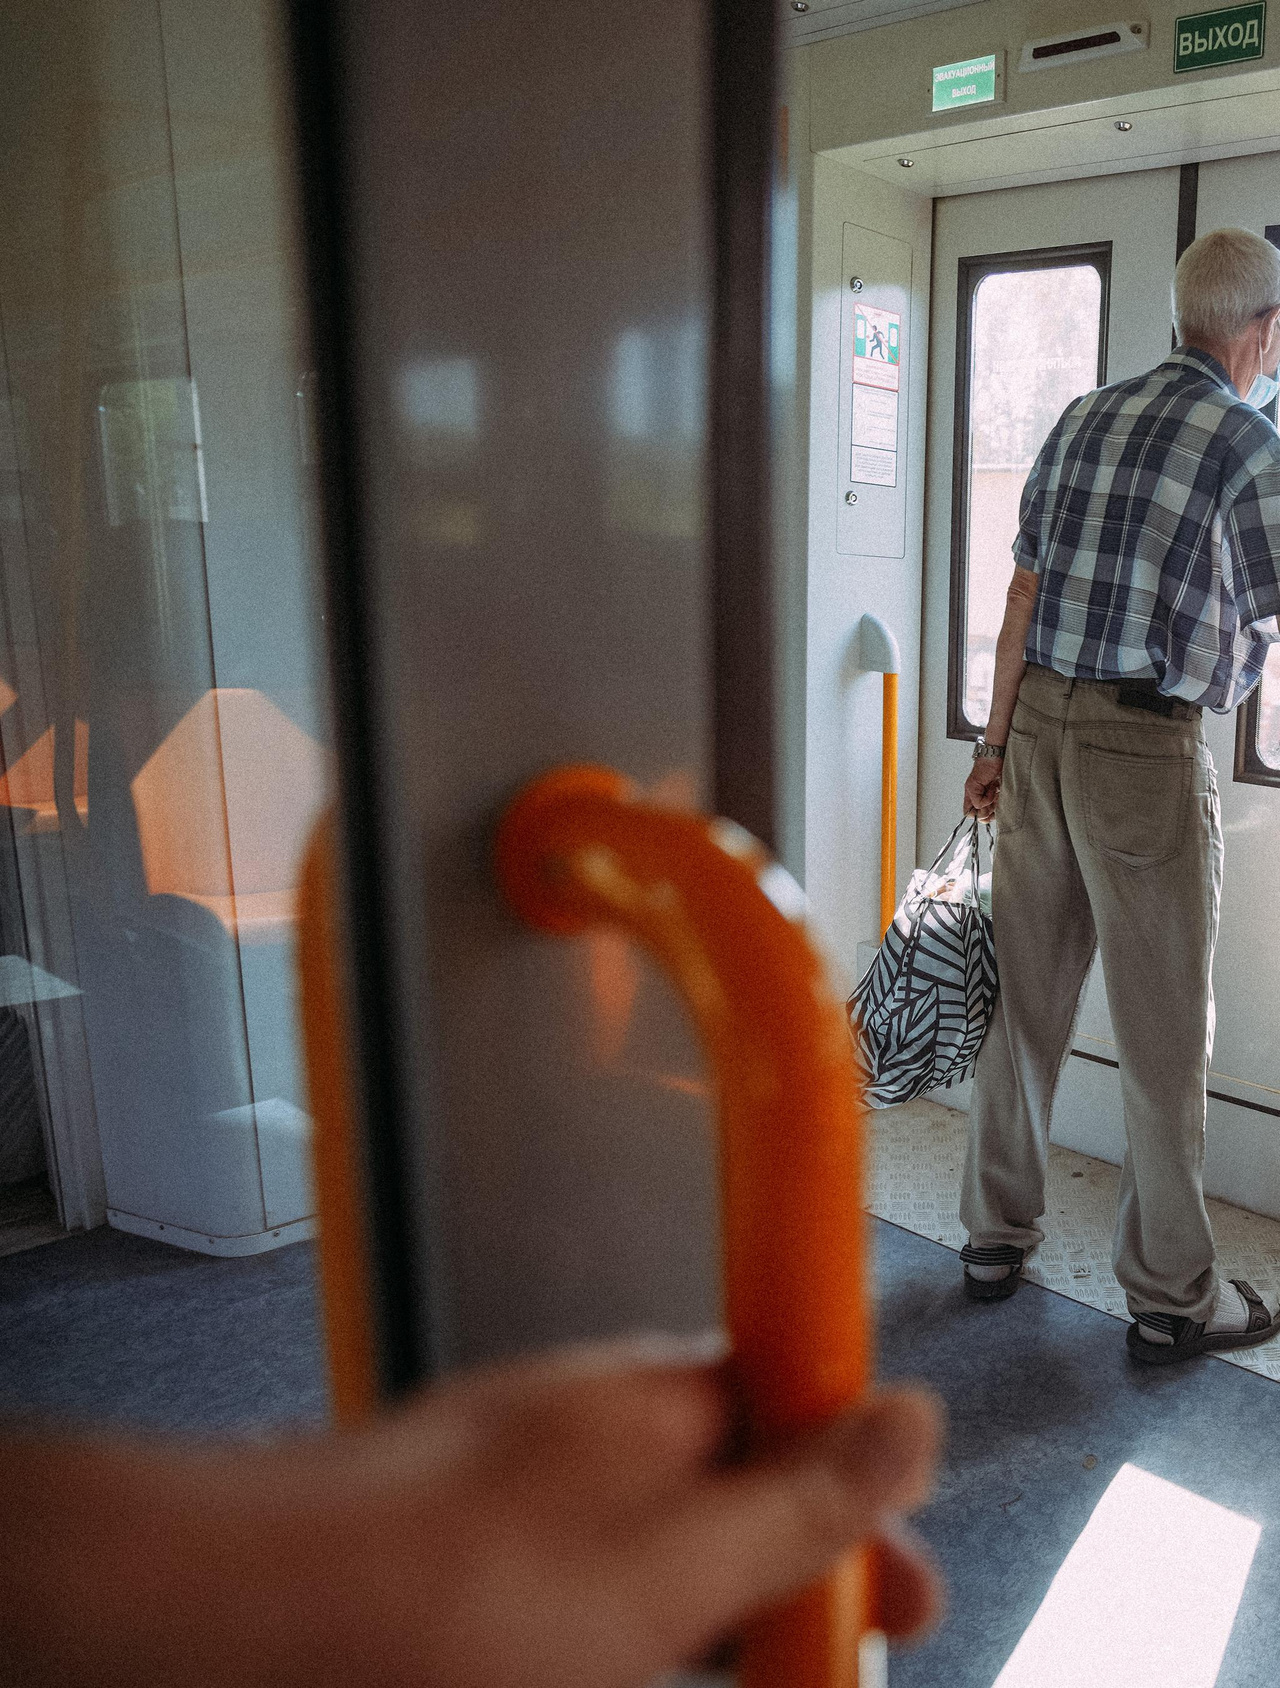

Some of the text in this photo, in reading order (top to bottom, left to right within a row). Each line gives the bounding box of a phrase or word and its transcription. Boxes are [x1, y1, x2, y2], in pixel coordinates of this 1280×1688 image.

[1178, 19, 1259, 57] ВЫХОД
[934, 60, 995, 83] ЭВАКУАЦИОННЫЙ
[951, 84, 977, 98] ВЫХОД
